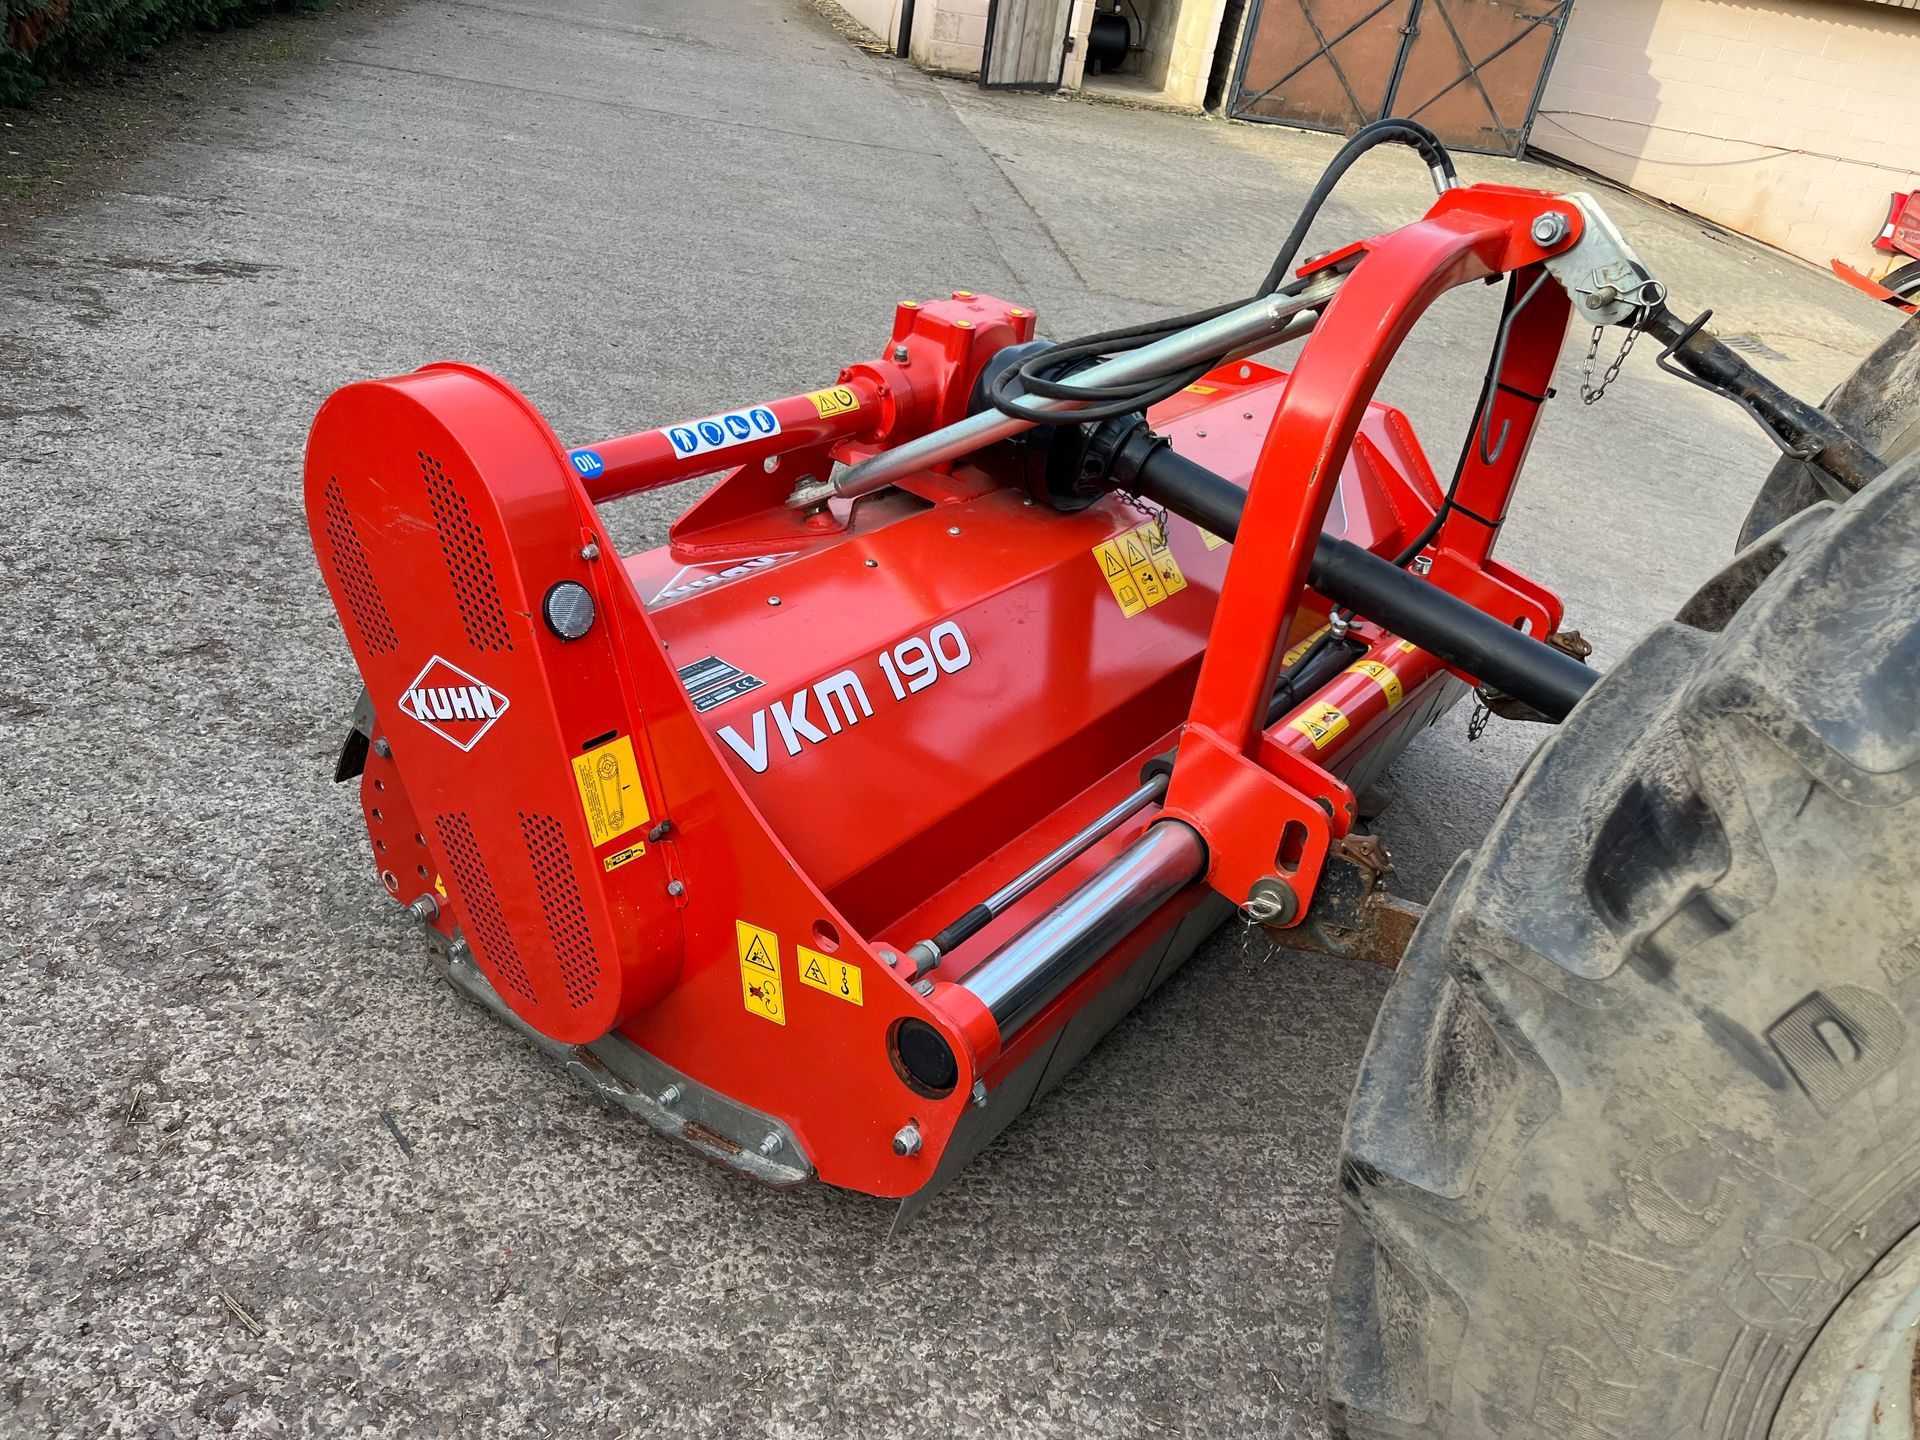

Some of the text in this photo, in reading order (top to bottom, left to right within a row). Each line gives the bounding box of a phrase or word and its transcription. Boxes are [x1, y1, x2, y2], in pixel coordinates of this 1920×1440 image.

[574, 453, 601, 473] OIL
[408, 684, 498, 721] KUHN
[716, 620, 971, 774] VKM 190
